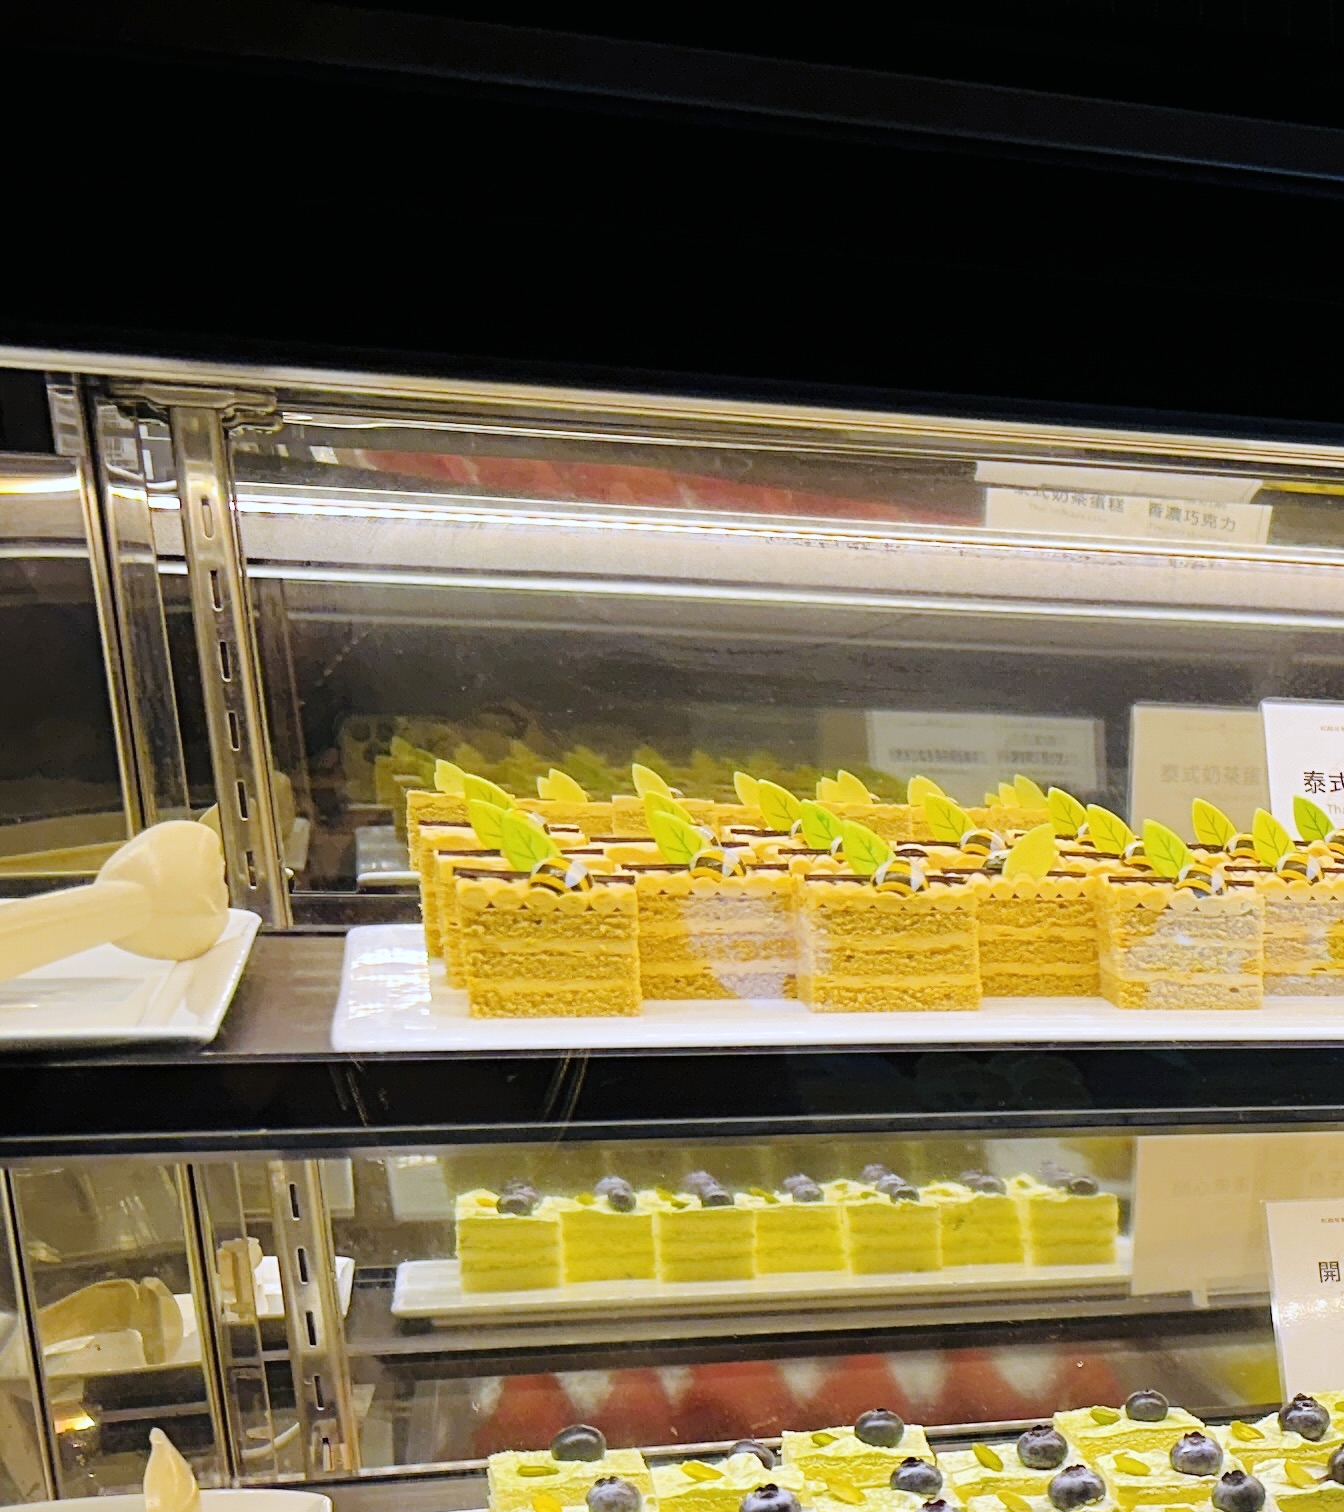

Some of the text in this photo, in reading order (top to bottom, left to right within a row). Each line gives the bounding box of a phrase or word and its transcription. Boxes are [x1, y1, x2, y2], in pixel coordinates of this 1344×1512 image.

[1013, 488, 1125, 514] 式奶茶蛋糕
